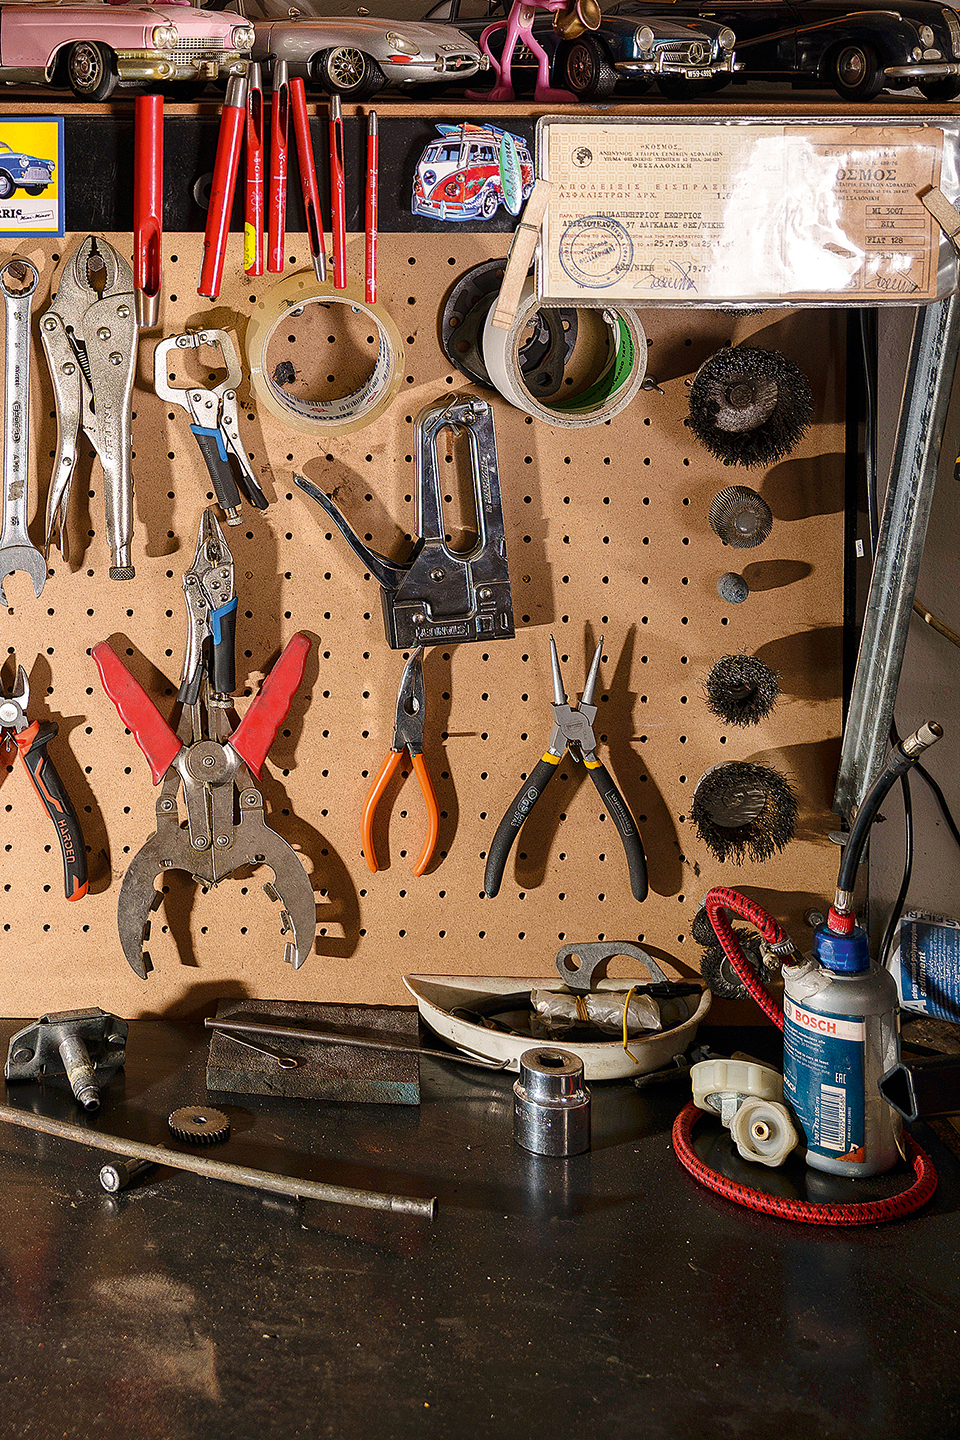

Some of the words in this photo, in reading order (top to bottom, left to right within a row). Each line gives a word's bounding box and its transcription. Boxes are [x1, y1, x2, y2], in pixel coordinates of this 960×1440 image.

[836, 168, 898, 182] ΟΣΜΟΣ
[558, 183, 641, 191] ΑΠΟΔΕΙΞΙΣ
[625, 220, 635, 229] 37
[654, 240, 689, 248] 25.7.83
[866, 236, 886, 244] FIAT
[891, 236, 904, 244] 128
[57, 819, 76, 864] HARDEN
[906, 910, 942, 923] FILTRI
[918, 951, 928, 997] sediment
[795, 1009, 837, 1034] BOSCH
[835, 1072, 847, 1085] EAC
